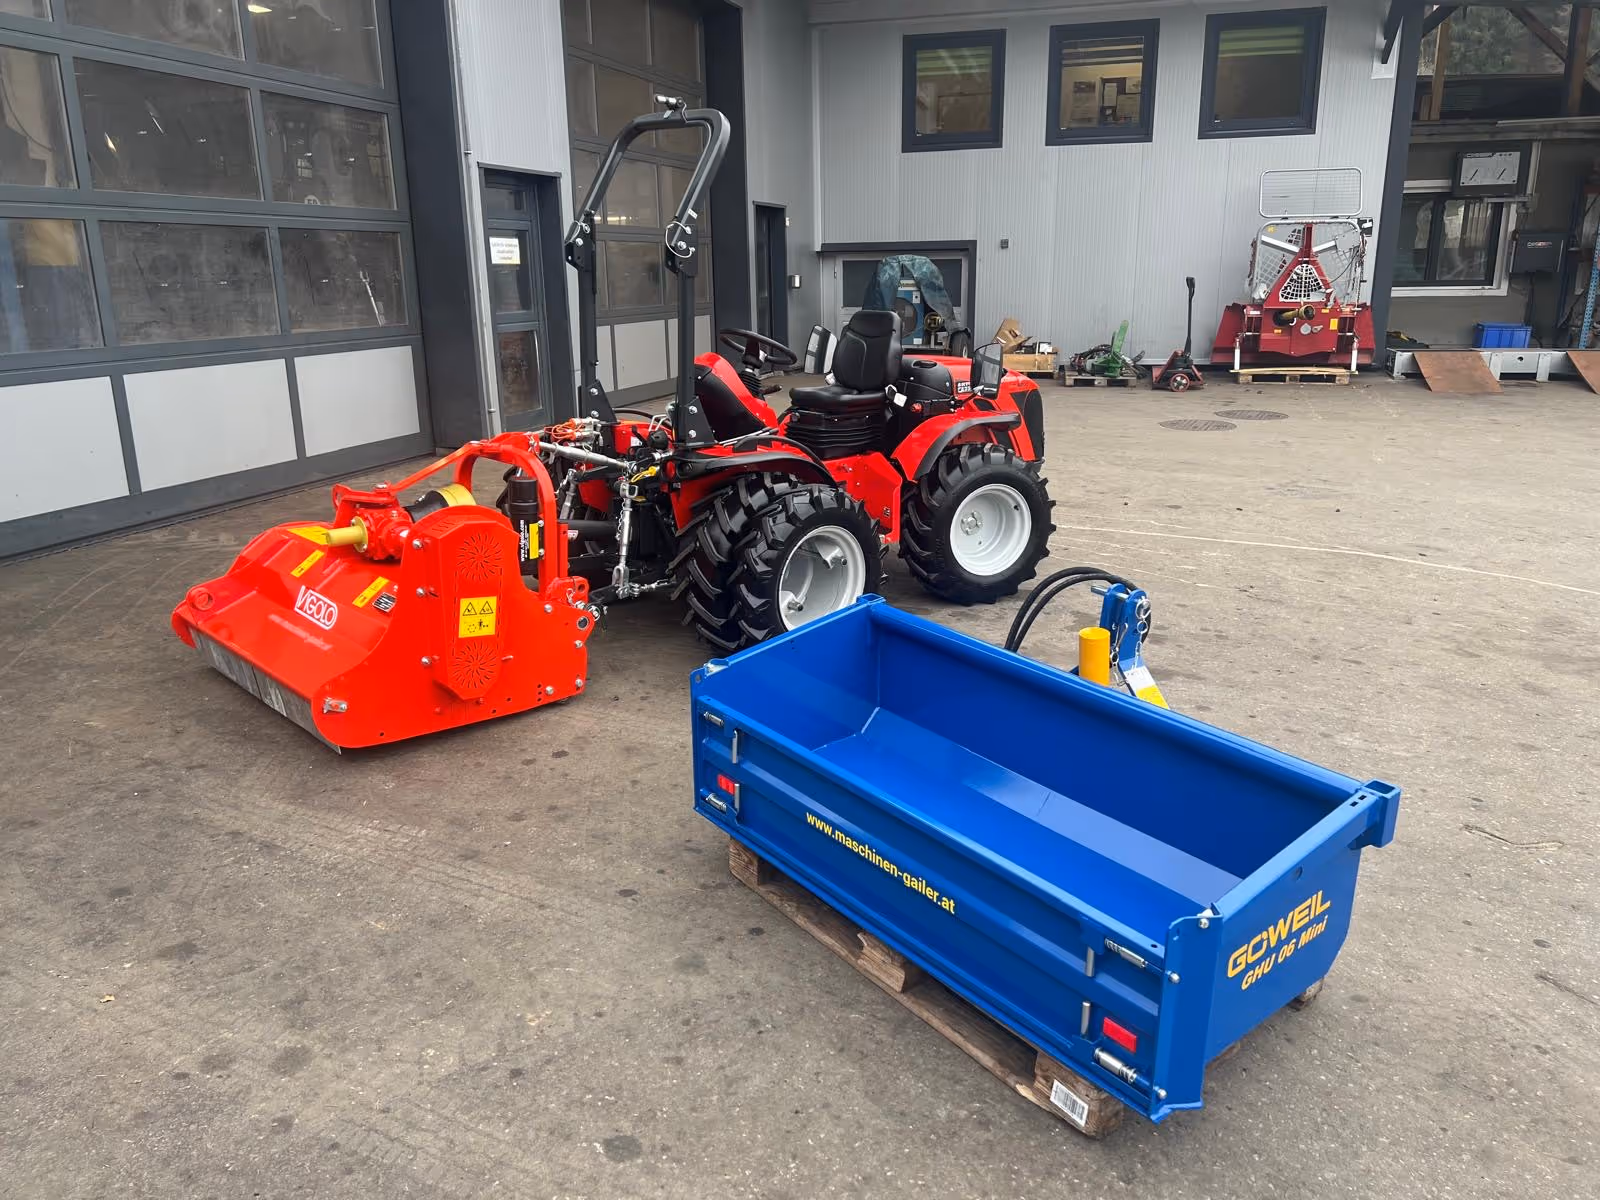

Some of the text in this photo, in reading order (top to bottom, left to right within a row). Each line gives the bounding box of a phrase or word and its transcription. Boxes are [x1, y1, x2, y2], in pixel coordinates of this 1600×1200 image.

[295, 585, 336, 627] VIGOLO
[806, 811, 956, 914] www.maschinen-gailer.at
[1241, 915, 1328, 990] GHU 06 Mini
